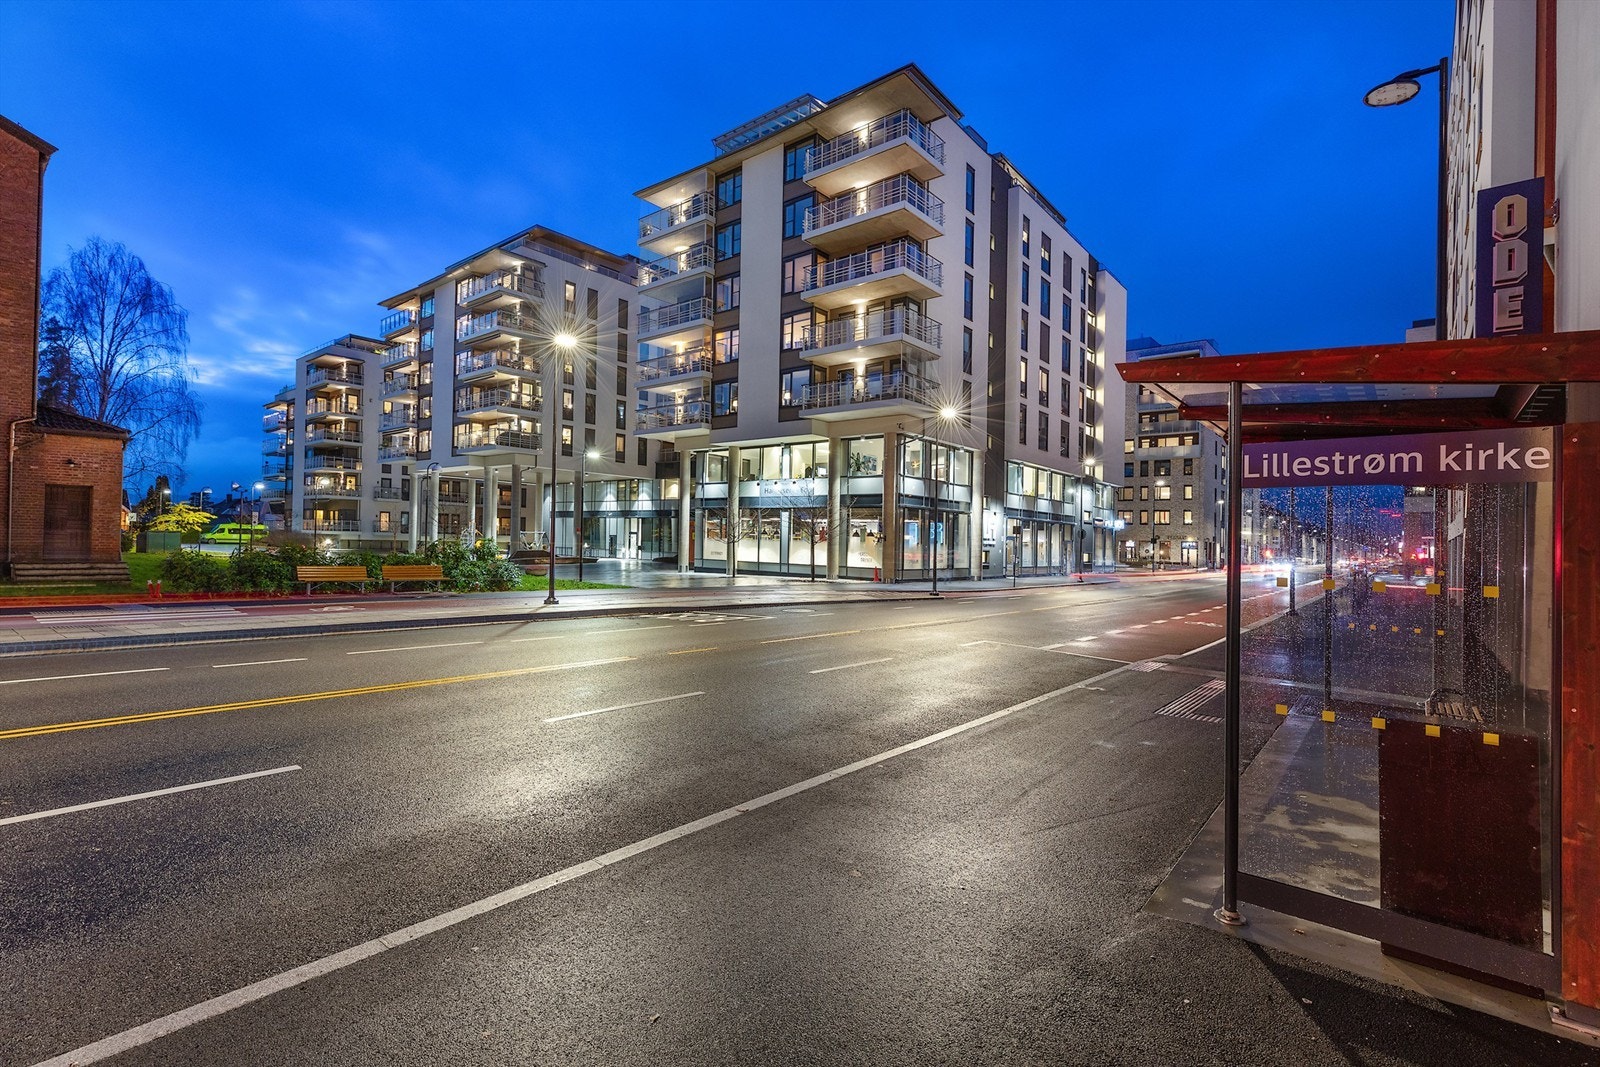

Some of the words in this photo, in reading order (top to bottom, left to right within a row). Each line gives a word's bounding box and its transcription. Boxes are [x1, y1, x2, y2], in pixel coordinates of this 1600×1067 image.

[1492, 193, 1529, 337] ODE
[1243, 450, 1423, 479] Lillestrøm
[1439, 441, 1551, 472] kirke
